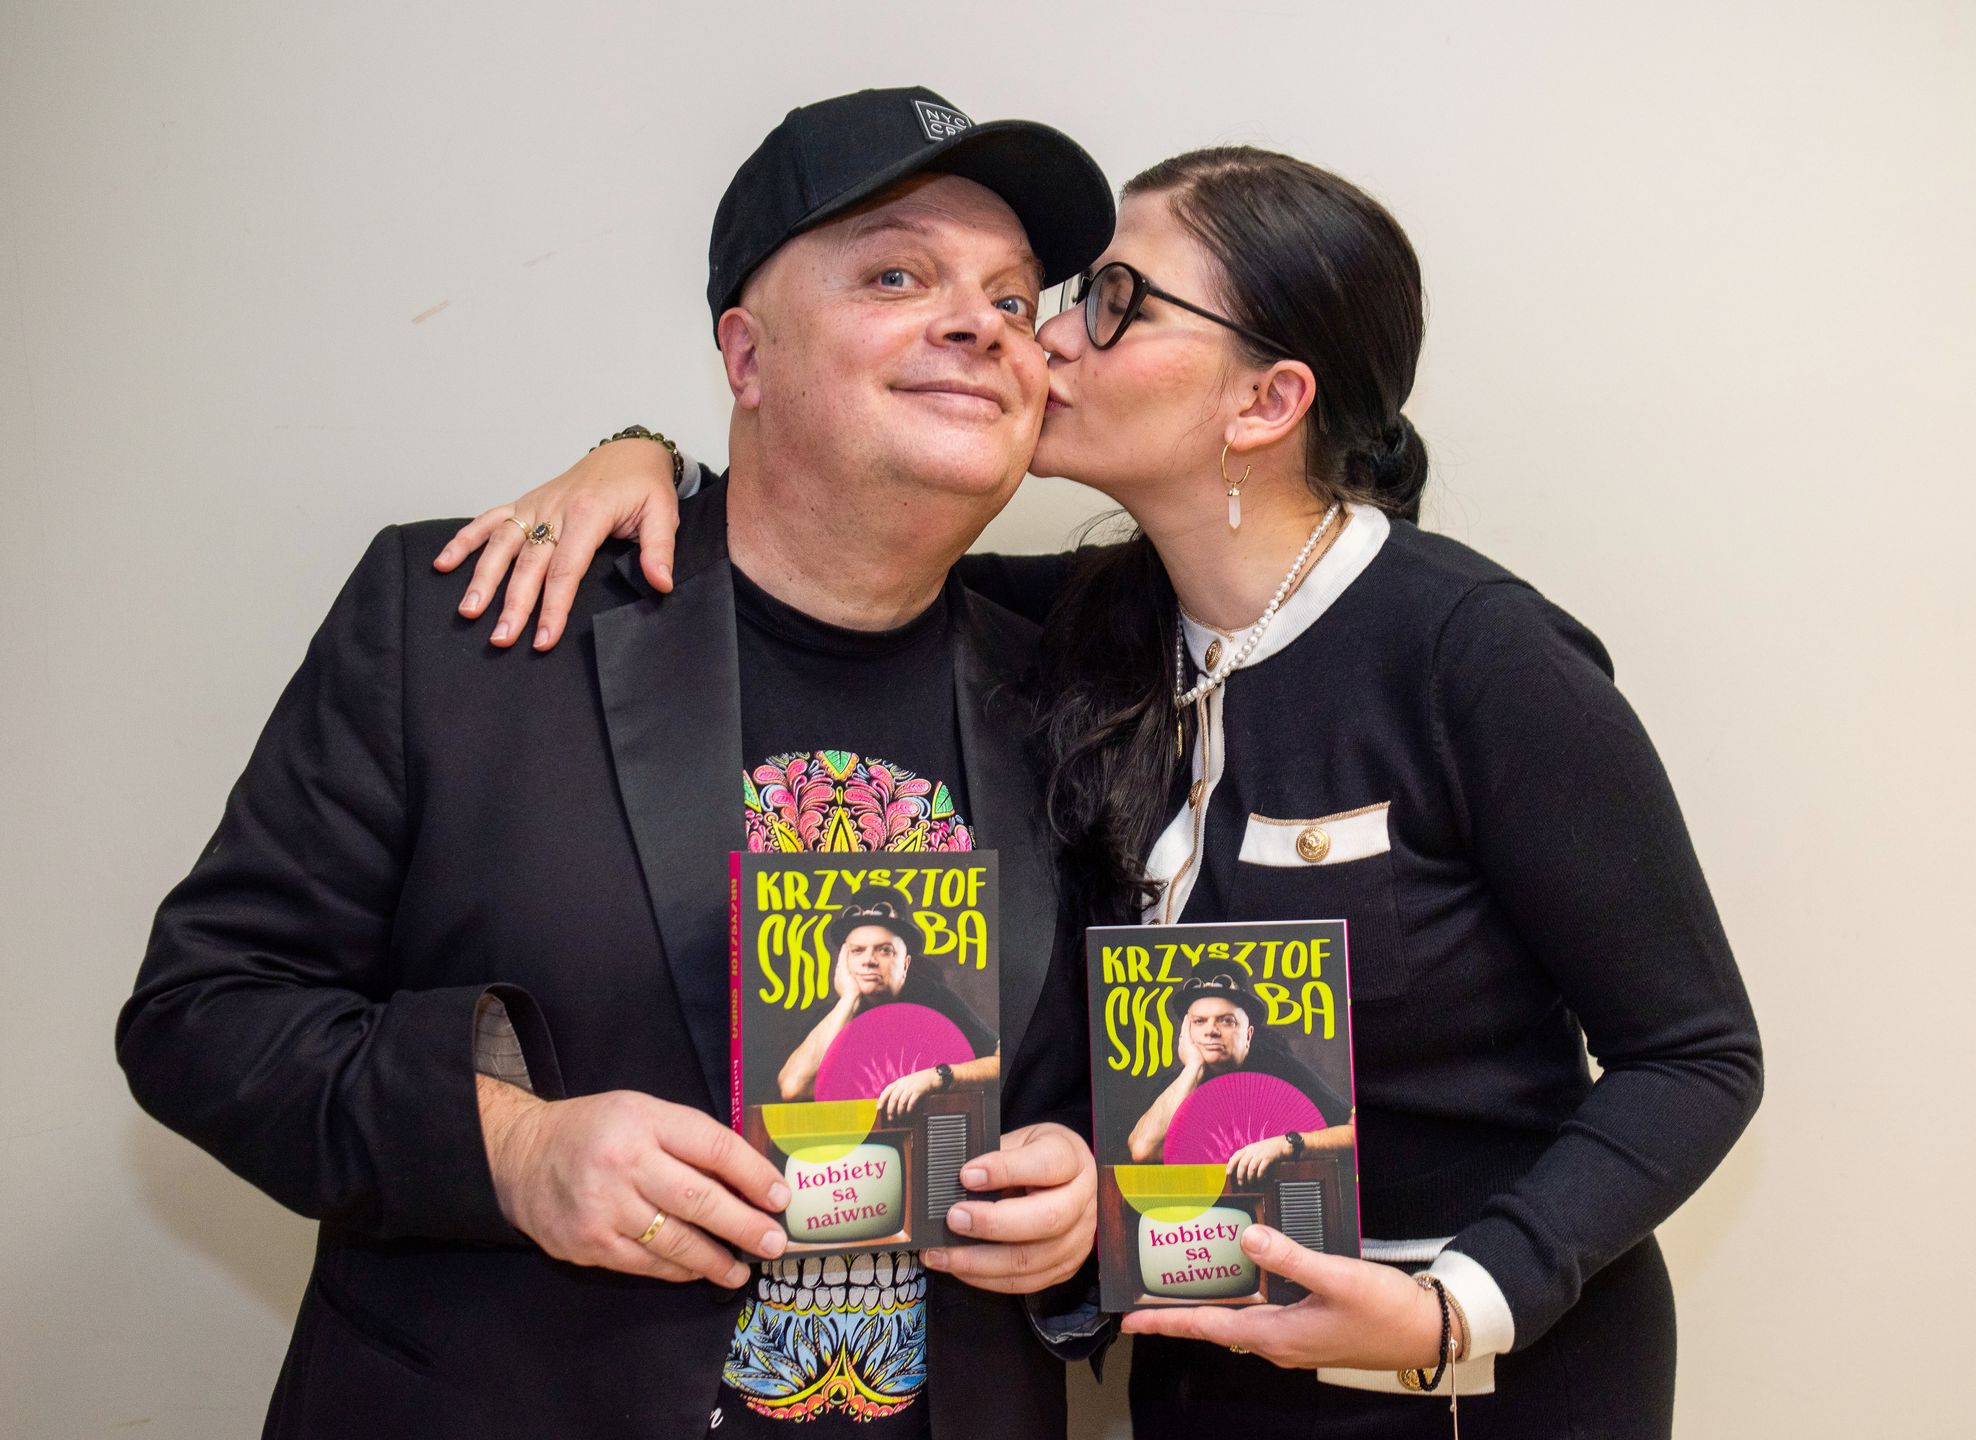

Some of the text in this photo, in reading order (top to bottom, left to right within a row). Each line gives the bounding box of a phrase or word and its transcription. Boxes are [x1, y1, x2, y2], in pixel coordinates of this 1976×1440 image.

[925, 108, 967, 129] NYC
[757, 867, 986, 911] KRZYSZTOF
[1102, 938, 1331, 984] KRZYSZTOF
[797, 1159, 888, 1190] kobiety
[832, 1185, 858, 1204] są
[806, 1202, 888, 1231] naiwne
[1149, 1221, 1240, 1248] kobiety
[1185, 1245, 1212, 1263] są
[1161, 1262, 1243, 1286] naiwne
